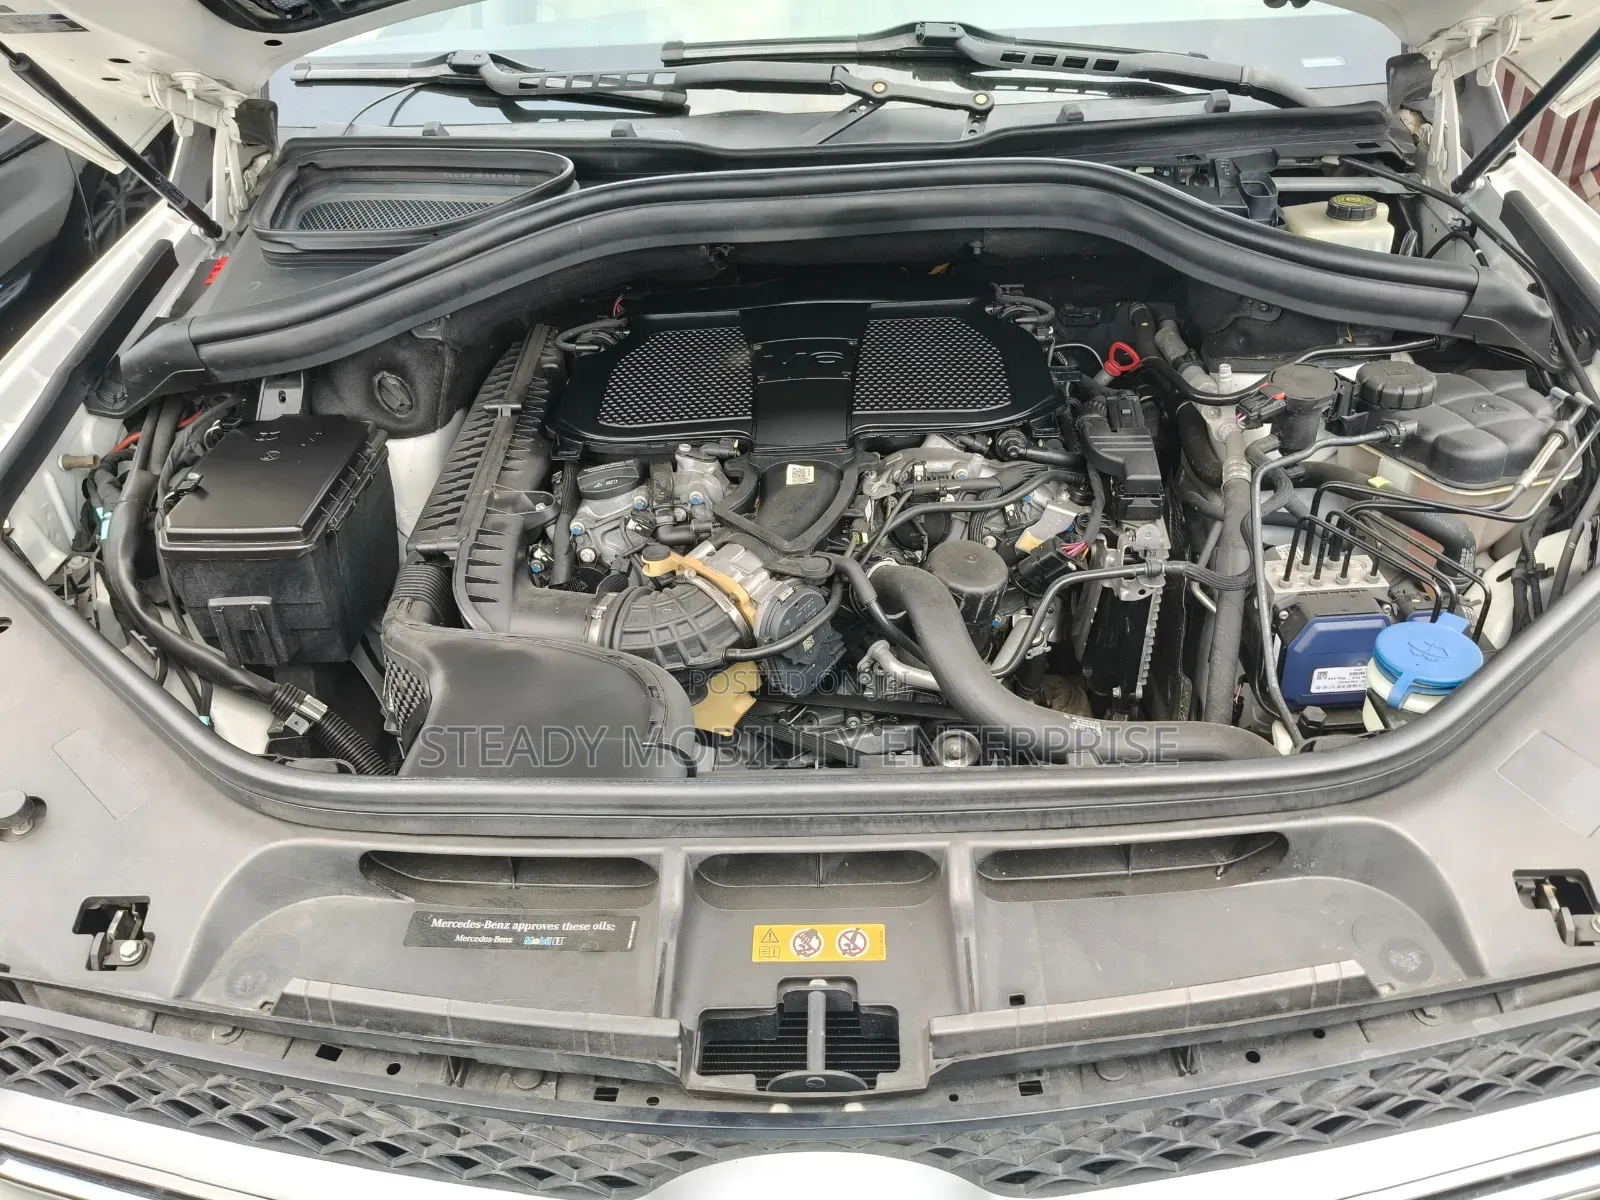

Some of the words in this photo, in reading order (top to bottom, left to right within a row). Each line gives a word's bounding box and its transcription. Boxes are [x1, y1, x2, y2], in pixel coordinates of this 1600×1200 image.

[431, 918, 510, 929] Mercedes-Benz
[511, 922, 560, 933] approves
[562, 921, 591, 931] these
[592, 920, 617, 932] oils:
[454, 934, 514, 944] Mercedes-Benz
[523, 936, 553, 946] Mobil
